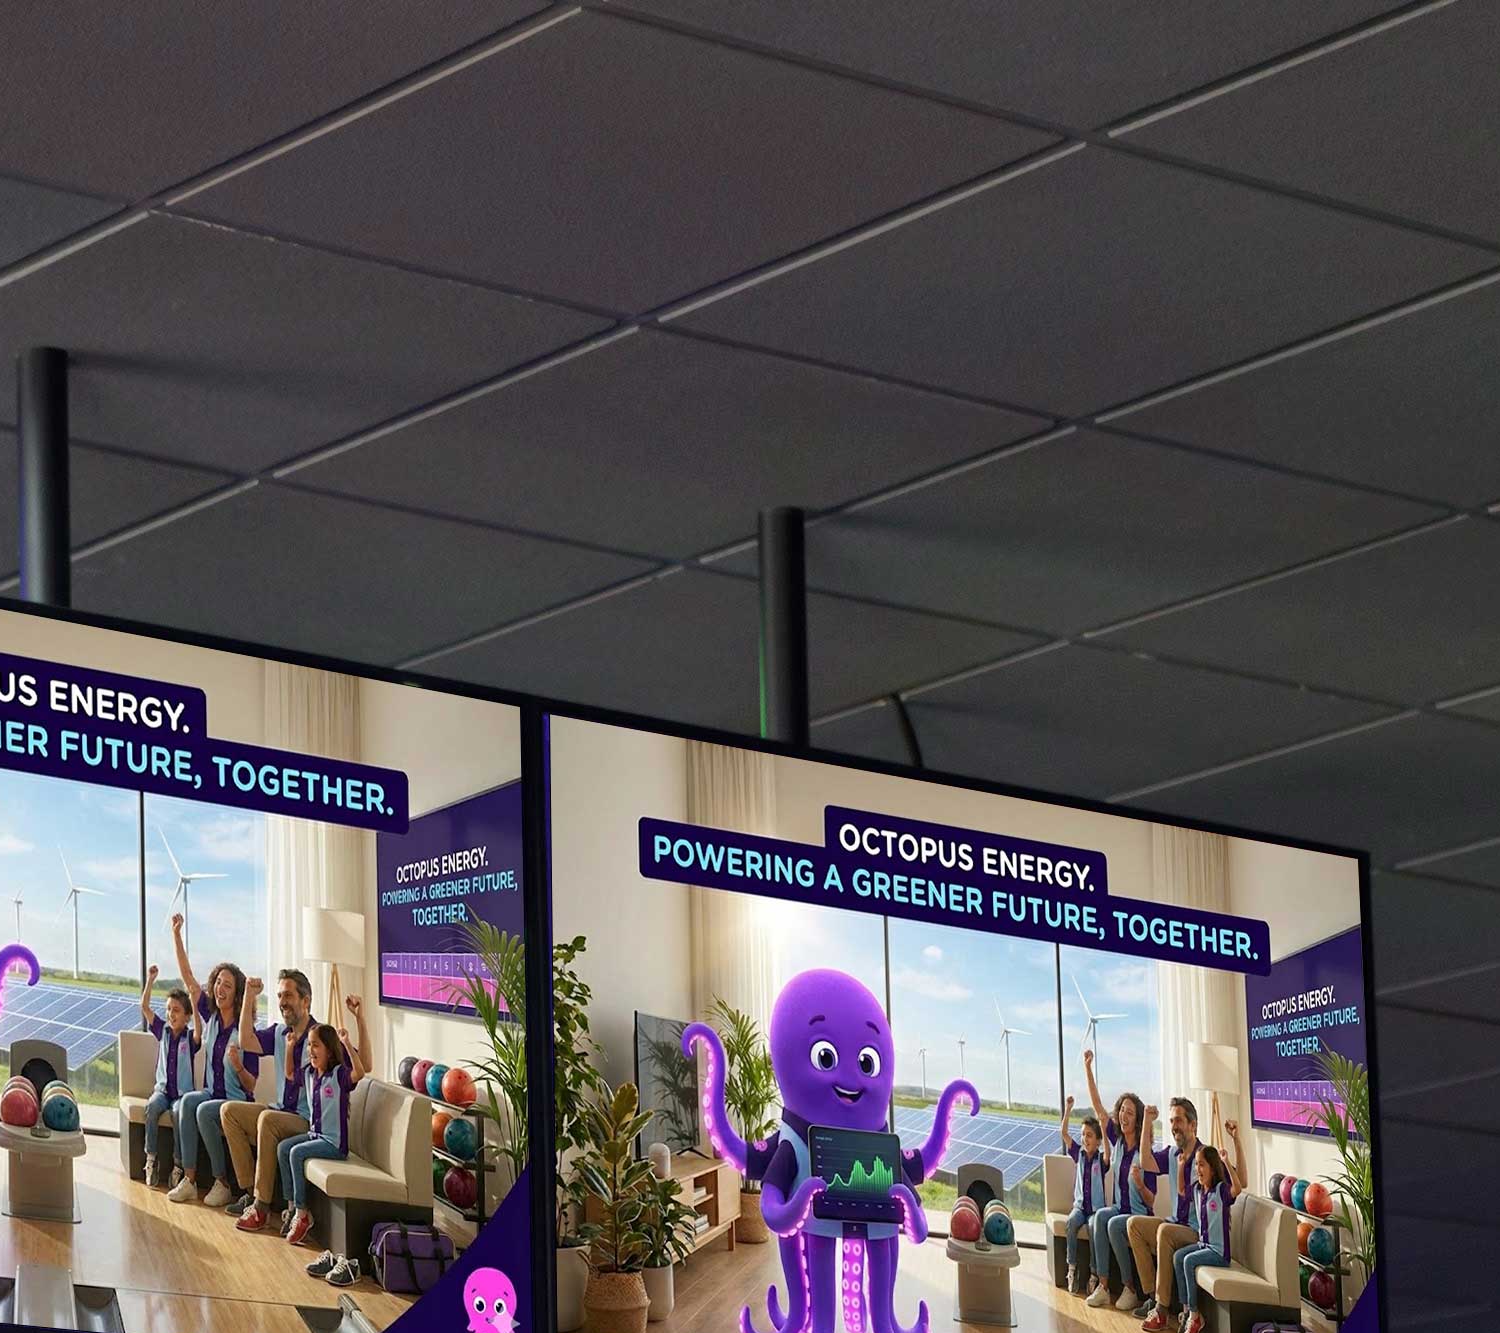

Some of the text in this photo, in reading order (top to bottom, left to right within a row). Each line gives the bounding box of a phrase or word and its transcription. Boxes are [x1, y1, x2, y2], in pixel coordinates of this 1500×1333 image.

[48, 678, 191, 735] ENERGY.
[60, 729, 203, 790] FUTURE,
[210, 754, 395, 817] TOGETHER.
[396, 846, 489, 884] OCTOPUS ENERGY.
[838, 822, 1096, 893] OCTOPUS ENERGY.
[382, 869, 518, 907] POWERING A GREENER FUTURE,
[653, 833, 1260, 961] POWERING A GREENER FUTURE, TOGETHER.
[411, 902, 469, 927] TOGETHER.
[1261, 985, 1336, 1020] OCTOPUS ENERGY.
[1251, 1006, 1360, 1041] POWERING A GREENER FUTURE,
[1275, 1035, 1322, 1057] TOGETHER.
